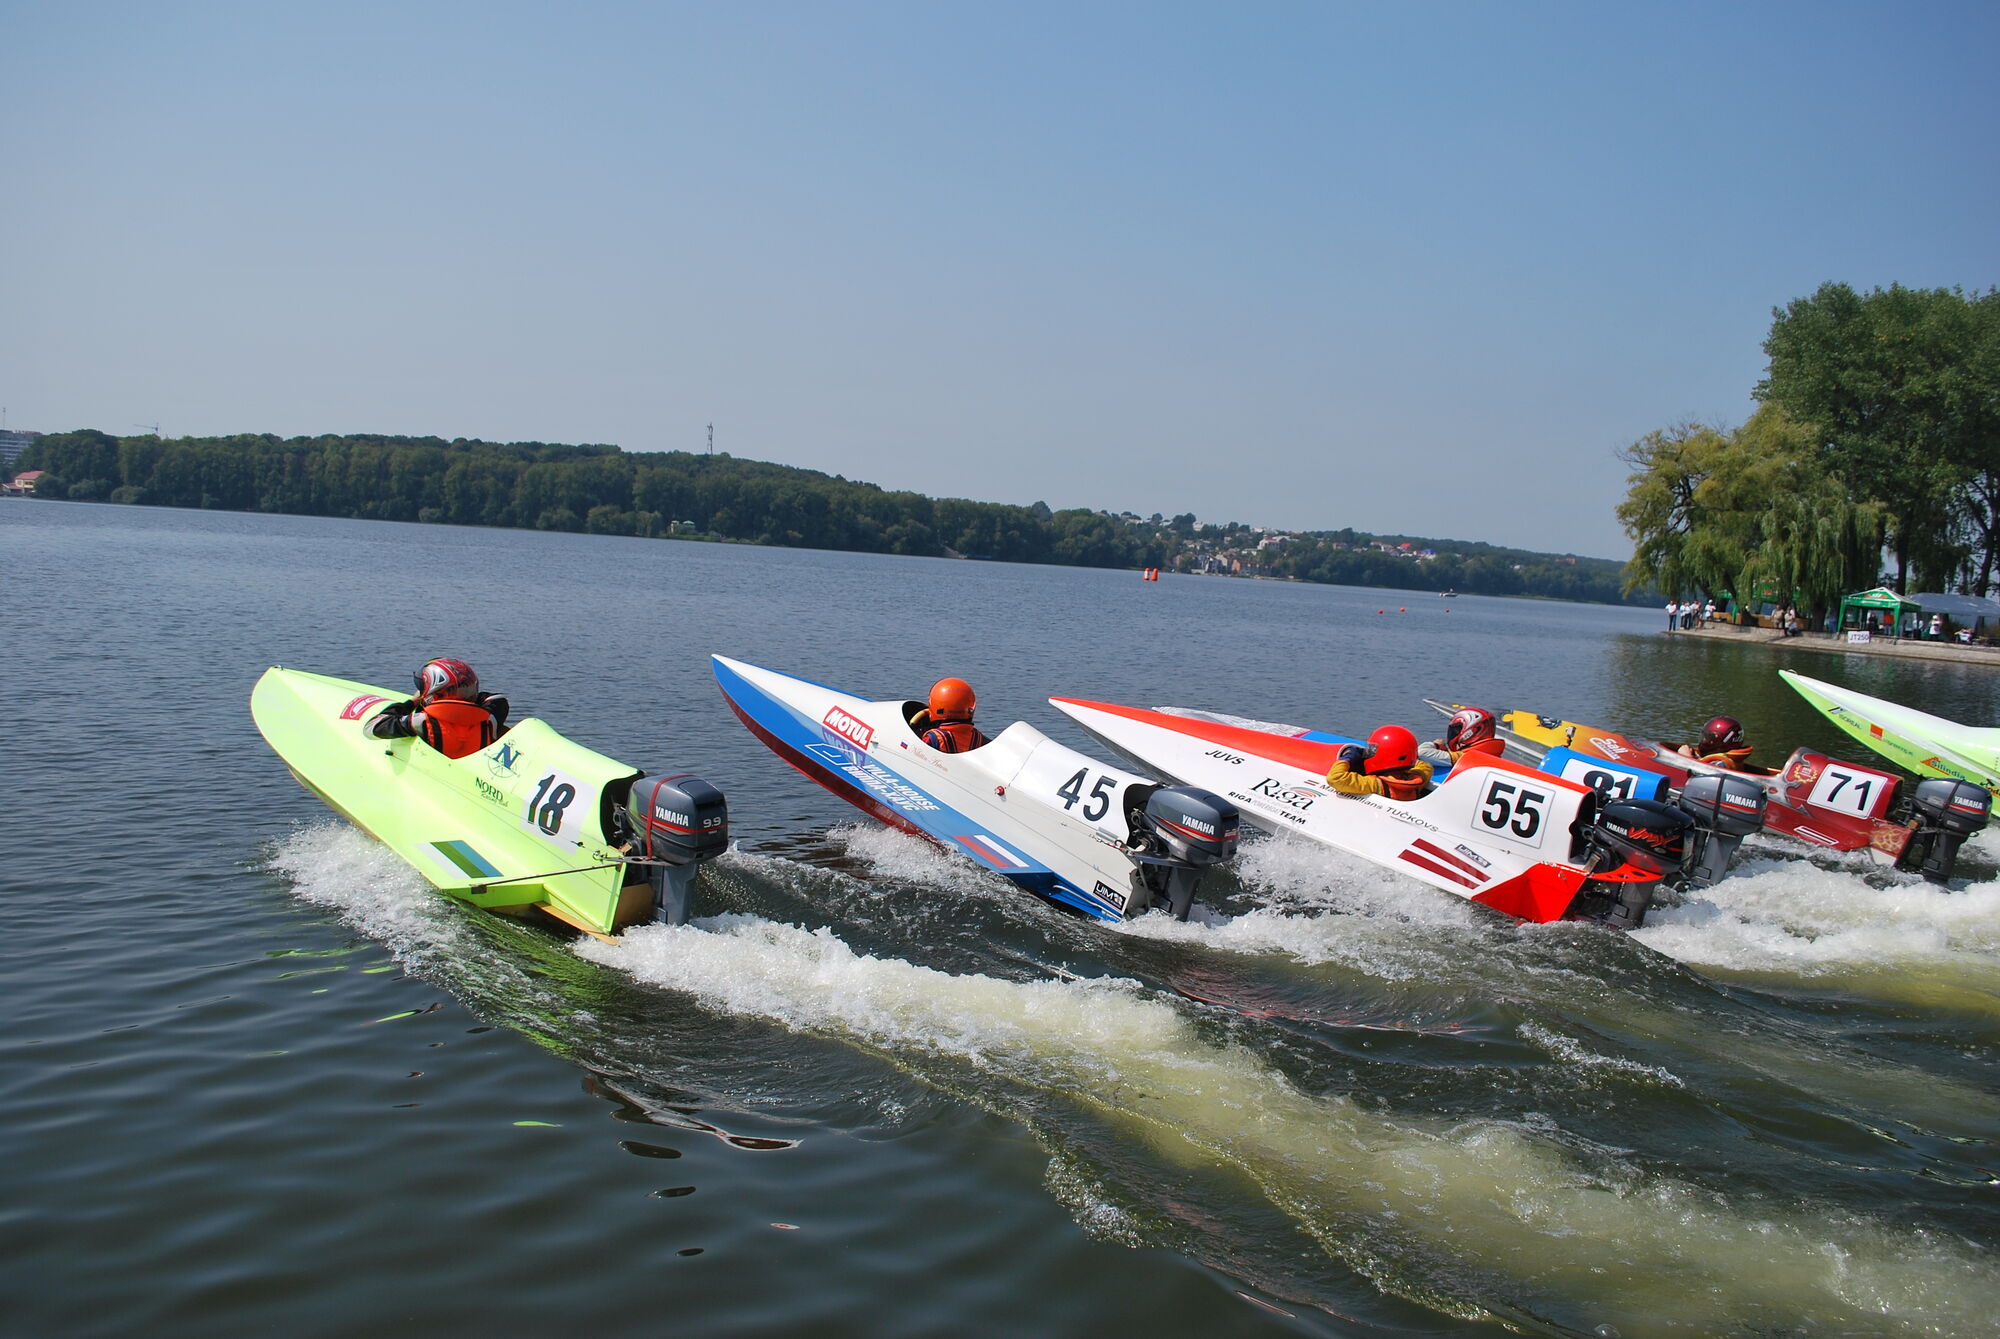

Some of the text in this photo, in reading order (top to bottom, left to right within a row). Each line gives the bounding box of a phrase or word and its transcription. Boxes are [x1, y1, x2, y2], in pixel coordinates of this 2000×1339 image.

[825, 709, 870, 747] MOTUL
[1205, 750, 1245, 765] JUVS
[475, 777, 503, 801] NORD
[862, 763, 940, 811] VILLA-HOUSE
[1056, 767, 1118, 822] 45
[1248, 777, 1314, 810] Riga
[1827, 771, 1872, 811] 71
[528, 774, 576, 836] 18
[1228, 791, 1252, 803] RIGA
[1280, 811, 1306, 825] TEAM
[1481, 780, 1545, 839] 55
[1725, 793, 1757, 809] YAMAHA
[1954, 796, 1984, 810] YAMAHA
[655, 806, 689, 827] YAMAHA
[703, 817, 722, 828] 9.9
[1182, 814, 1215, 836] YAMAHA
[1386, 806, 1439, 832] TUČKOVS
[1606, 822, 1628, 837] YAMAHA
